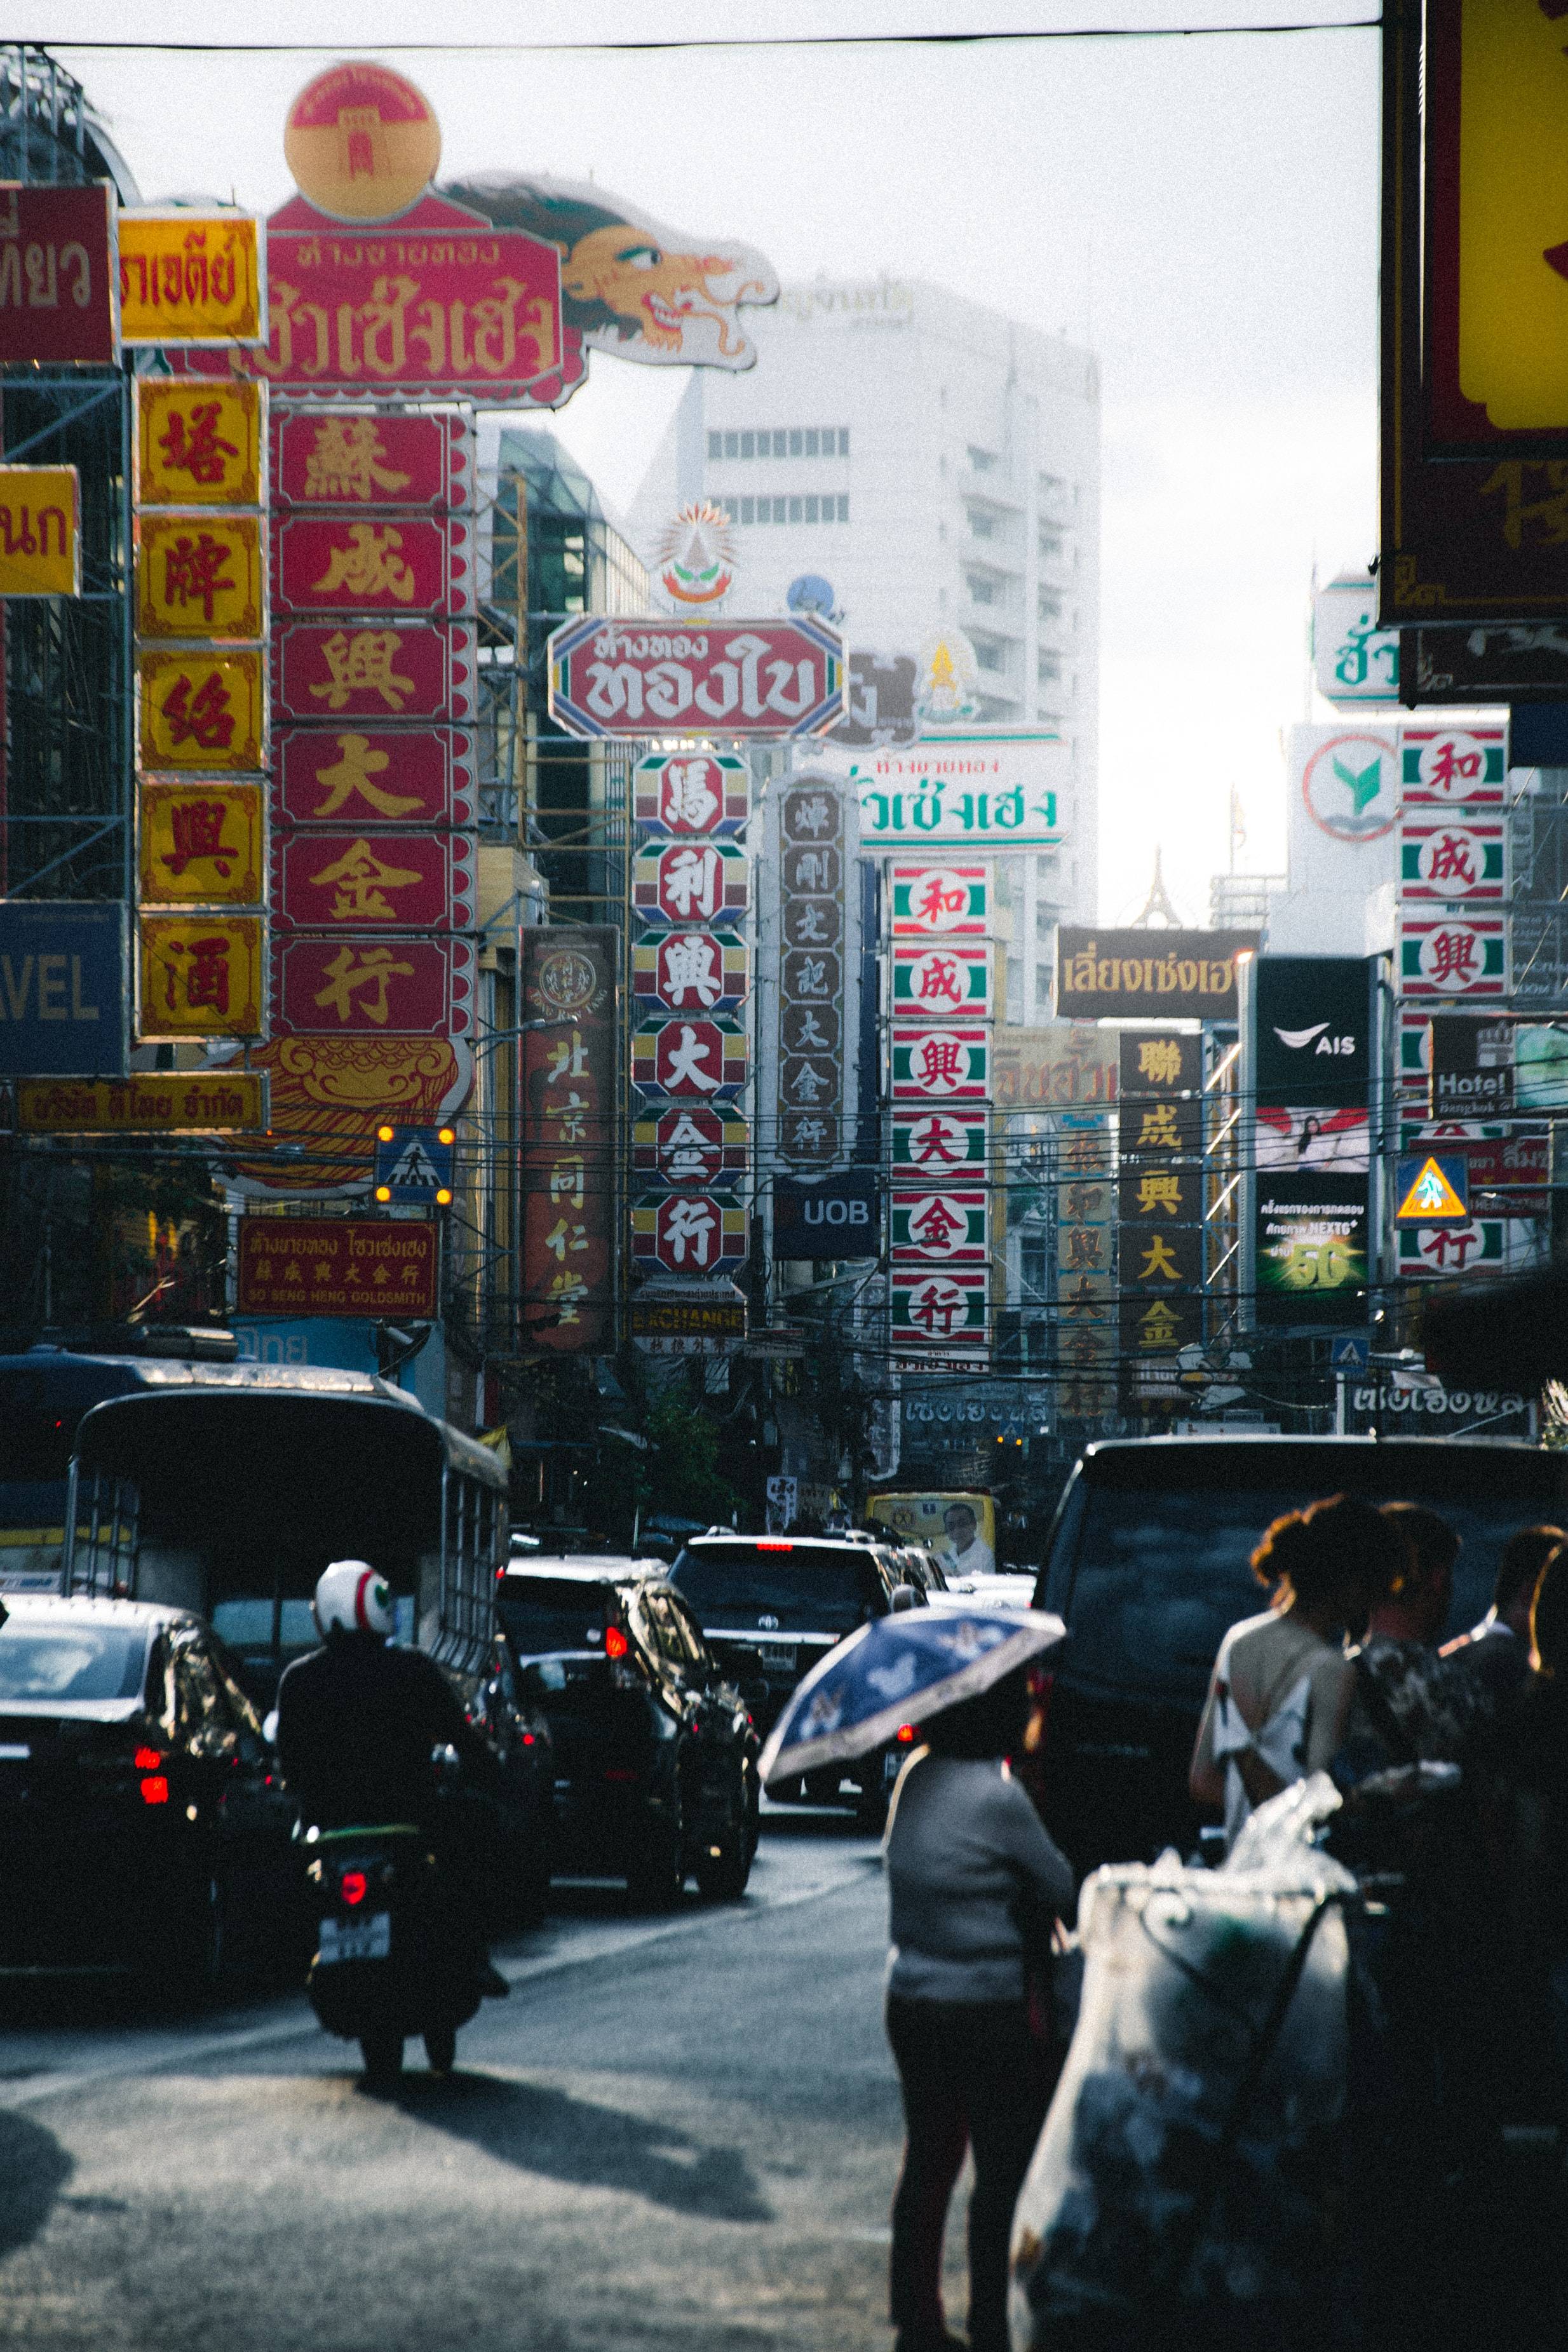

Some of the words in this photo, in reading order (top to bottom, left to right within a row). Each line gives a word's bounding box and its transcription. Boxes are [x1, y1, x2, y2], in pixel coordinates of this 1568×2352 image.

[593, 625, 709, 662] ห้างทอง
[585, 634, 816, 720] ทองใบ
[1064, 941, 1238, 995] เลี่ยงเซ่งเฮ
[1315, 1036, 1356, 1056] AIS
[1438, 1072, 1506, 1095] Hotel
[912, 879, 966, 1333] 和成興大金行
[546, 1030, 590, 1327] 北京同仁堂
[1136, 1039, 1183, 1350] 聯成興大金
[804, 1200, 869, 1225] UOB
[351, 1290, 426, 1305] GOLDSMITH
[633, 1308, 743, 1330] EXCHANGE
